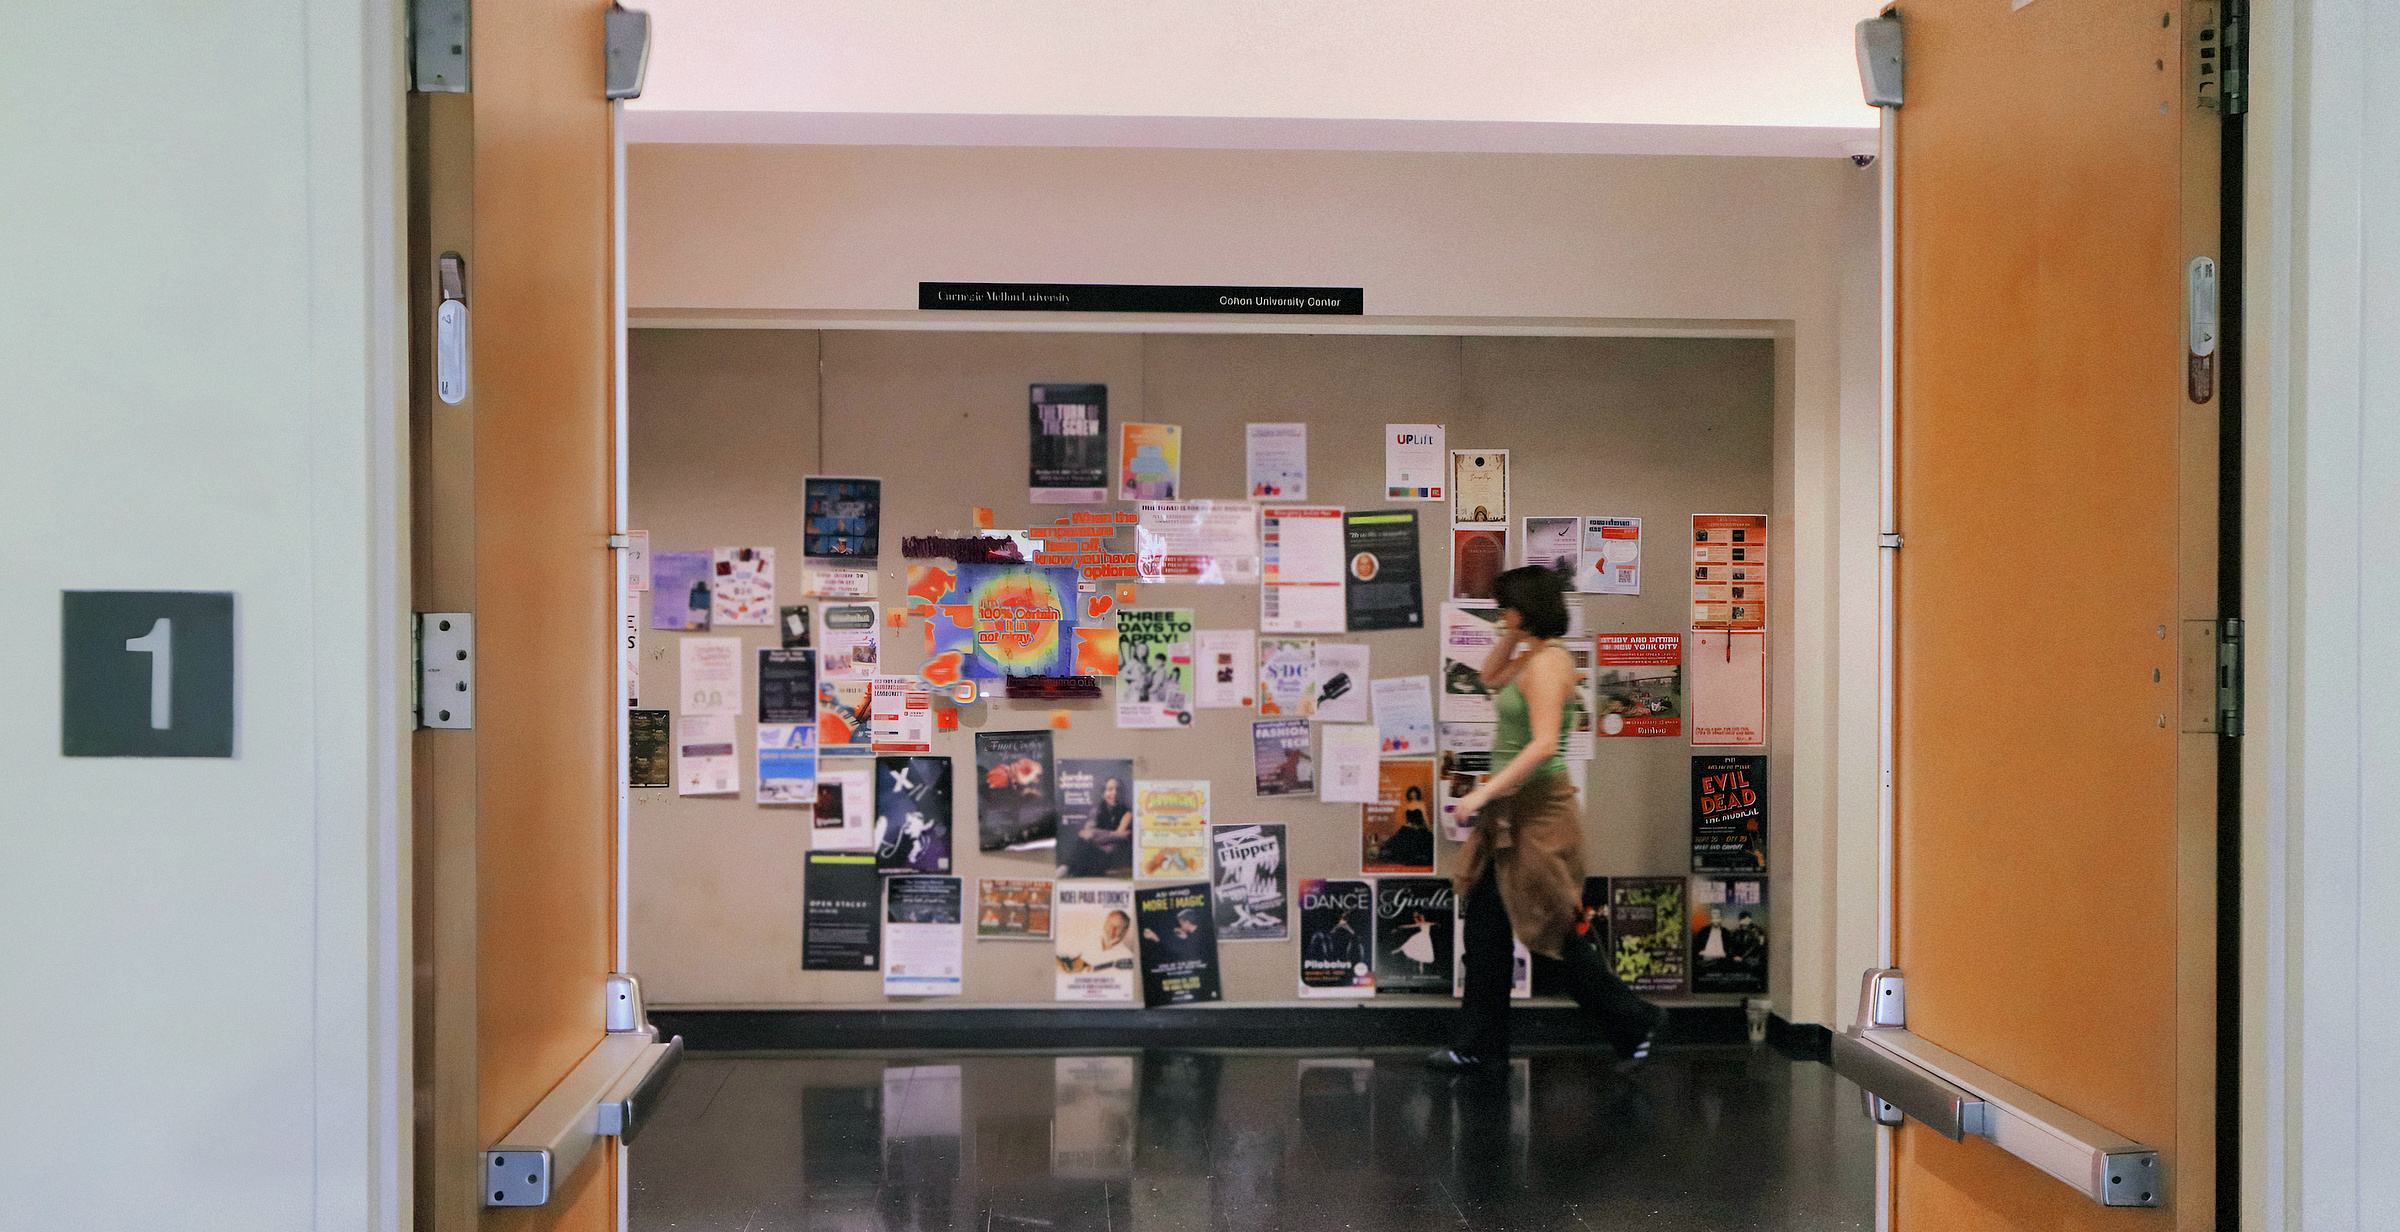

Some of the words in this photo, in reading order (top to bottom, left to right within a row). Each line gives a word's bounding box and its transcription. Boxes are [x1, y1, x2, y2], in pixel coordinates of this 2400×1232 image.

[938, 291, 984, 302] Carnegie
[986, 291, 1020, 302] Mellon
[1022, 292, 1070, 305] University
[1255, 297, 1305, 308] University
[1307, 297, 1341, 307] Center
[1397, 434, 1434, 445] UPLift
[1072, 511, 1113, 525] When
[1115, 511, 1138, 524] the
[1034, 550, 1074, 565] know
[1073, 553, 1101, 569] you
[1102, 551, 1137, 564] have
[979, 607, 1014, 620] 100%
[1118, 611, 1175, 622] THREE
[1118, 622, 1163, 632] DAYS
[1167, 622, 1191, 632] TO
[1119, 633, 1178, 643] APPLY!
[126, 618, 171, 729] 1
[1256, 726, 1309, 738] FASHION
[1281, 739, 1309, 749] TECH
[1702, 770, 1750, 794] EVIL
[1700, 788, 1756, 814] DEAD
[1722, 807, 1760, 822] MUSICAL
[1220, 840, 1276, 862] Flipper
[1175, 895, 1205, 907] MAGIC
[1304, 894, 1369, 910] DANCE
[1377, 887, 1453, 920] Giselle
